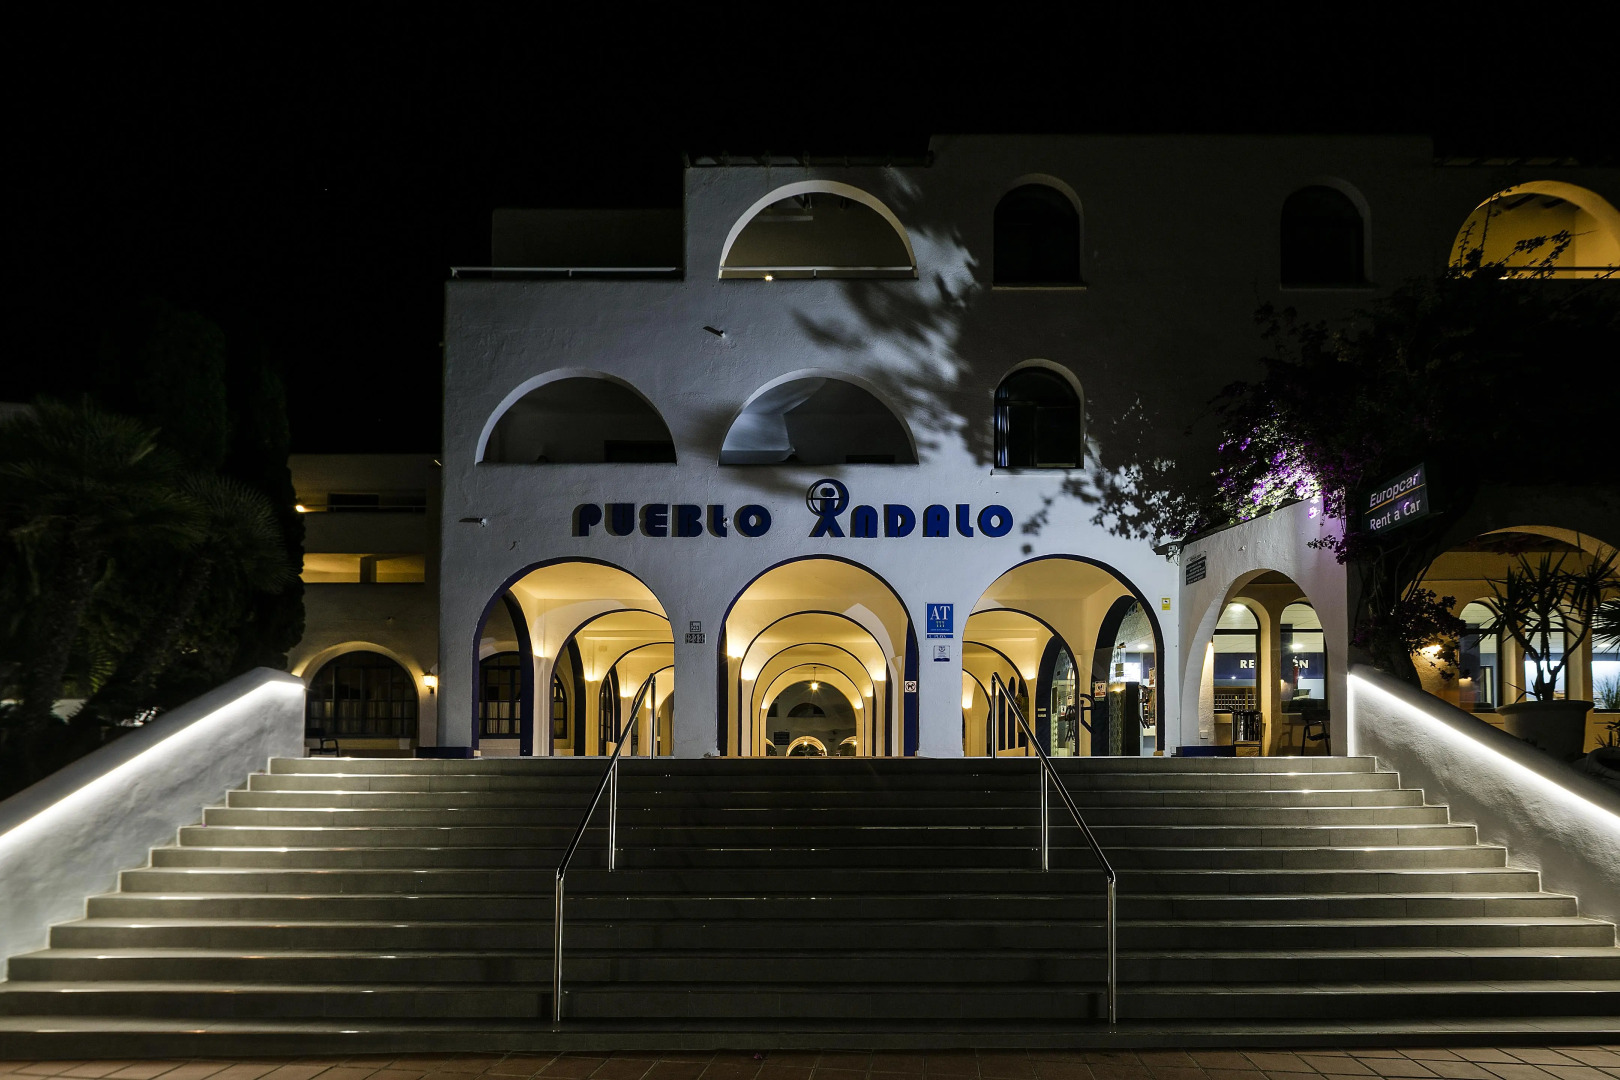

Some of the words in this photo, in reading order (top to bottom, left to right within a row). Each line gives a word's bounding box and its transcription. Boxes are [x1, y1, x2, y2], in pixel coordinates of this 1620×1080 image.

[1369, 472, 1419, 508] Europcar
[572, 503, 772, 538] PUEBLO
[1370, 511, 1391, 530] Rent
[1394, 510, 1400, 521] a
[1403, 500, 1421, 516] Car
[930, 605, 951, 620] AT
